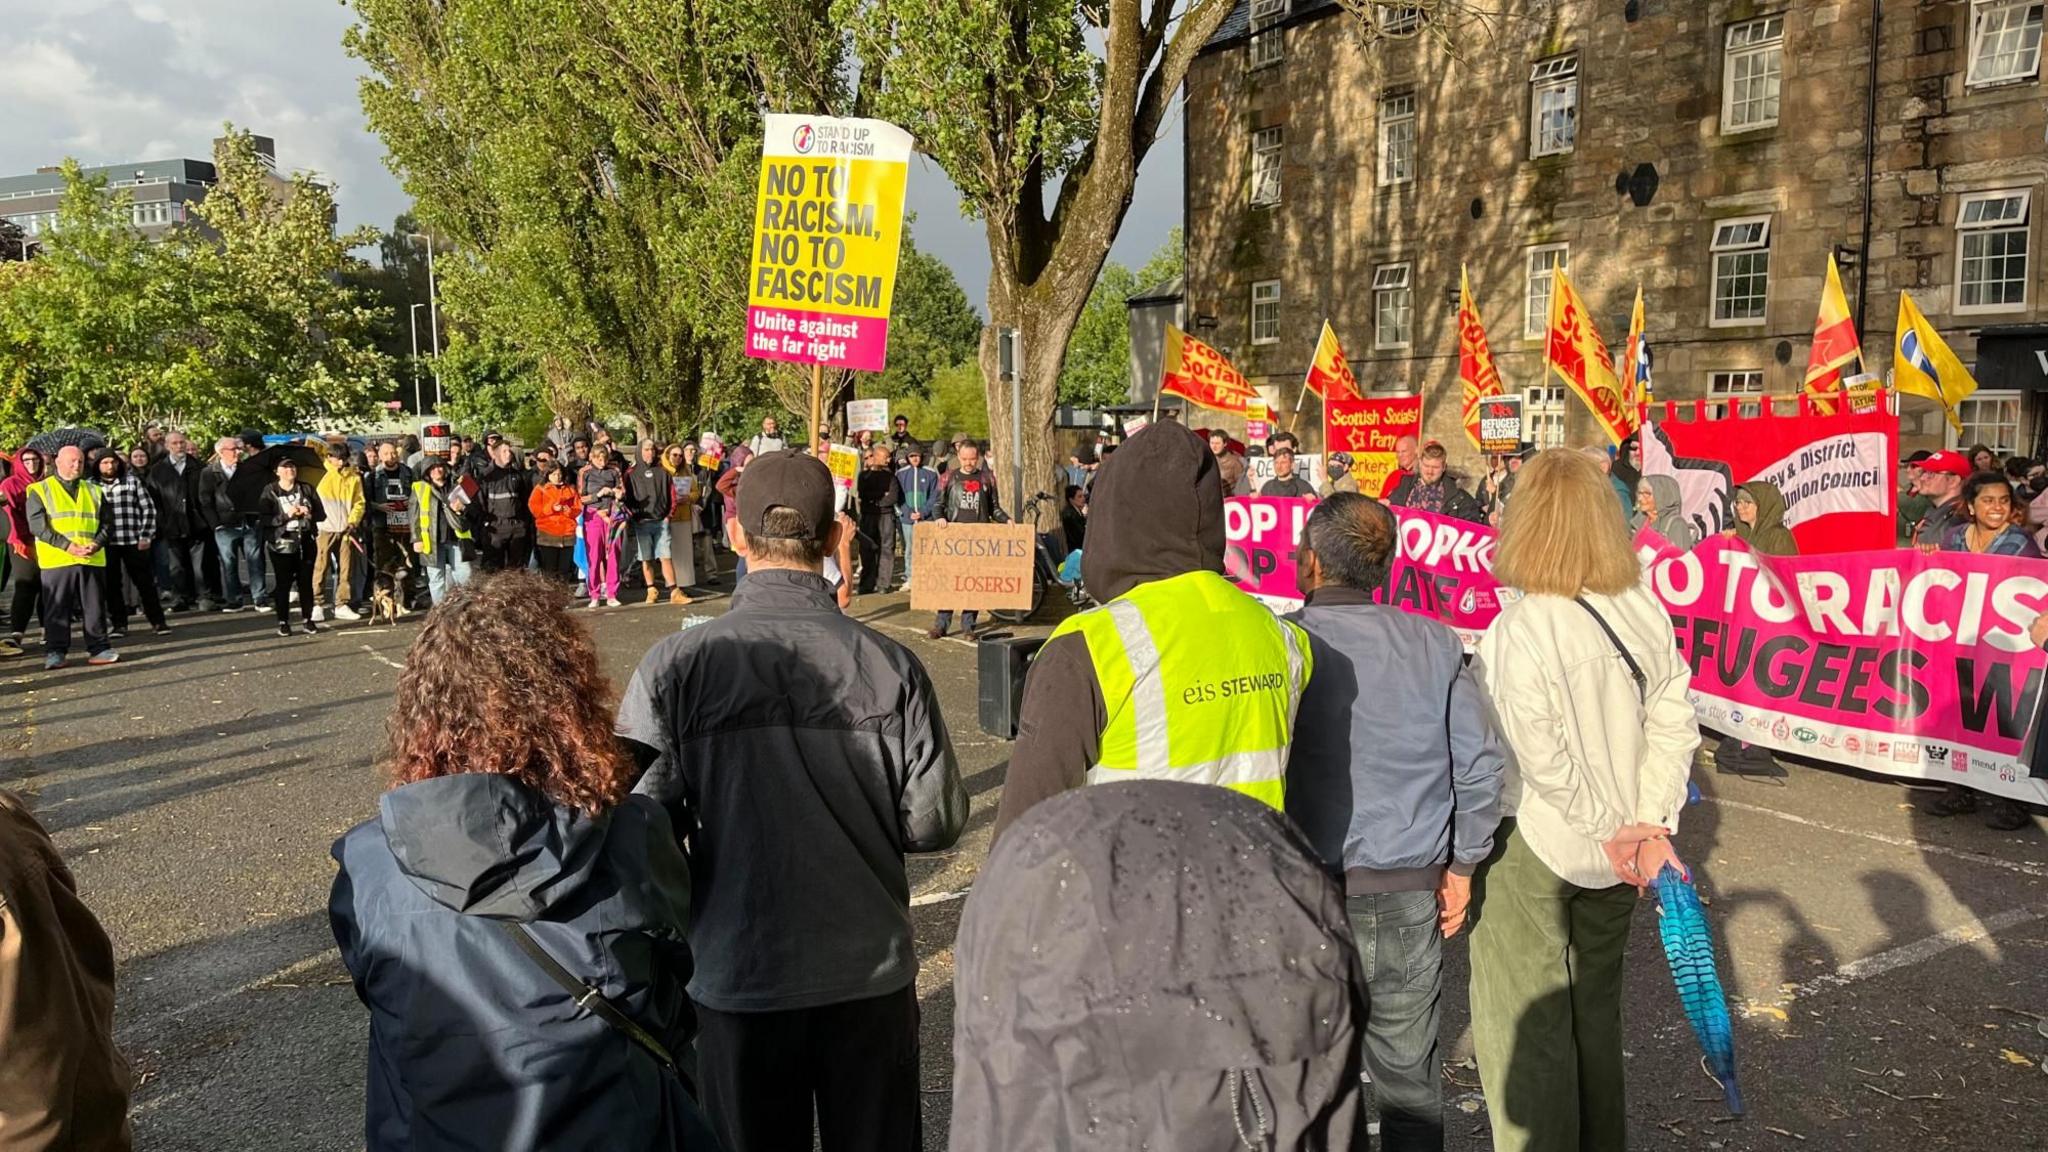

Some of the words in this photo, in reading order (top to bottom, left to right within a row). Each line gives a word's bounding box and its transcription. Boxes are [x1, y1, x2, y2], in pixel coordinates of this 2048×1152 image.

[817, 126, 850, 140] STAND
[853, 127, 870, 141] UP
[817, 140, 828, 153] TO
[830, 140, 875, 156] RACISM
[766, 164, 806, 197] NO
[812, 165, 848, 199] TO
[763, 198, 881, 242] RACISM,
[759, 232, 800, 266] NO
[808, 235, 846, 270] TO
[756, 266, 883, 309] FASCISM
[754, 310, 796, 332] Unite
[799, 318, 859, 339] against
[753, 332, 778, 351] the
[782, 334, 804, 354] far
[807, 338, 847, 361] right
[1330, 408, 1380, 426] Scottish
[1481, 418, 1520, 430] REFUGEES
[1369, 429, 1398, 451] Party
[1481, 428, 1520, 440] WELCOME
[1350, 459, 1389, 474] orkers
[1787, 462, 1797, 480] &
[1800, 440, 1856, 472] District
[1820, 467, 1881, 492] Counci
[920, 538, 1000, 557] FASCISM
[1007, 539, 1027, 557] IS
[955, 575, 1021, 594] LOSERS!
[1718, 549, 1797, 624] TO
[1795, 567, 2048, 653] RACIS
[1183, 679, 1216, 705] eis
[1221, 672, 1284, 698] STEWARD
[1971, 758, 1996, 772] mend
